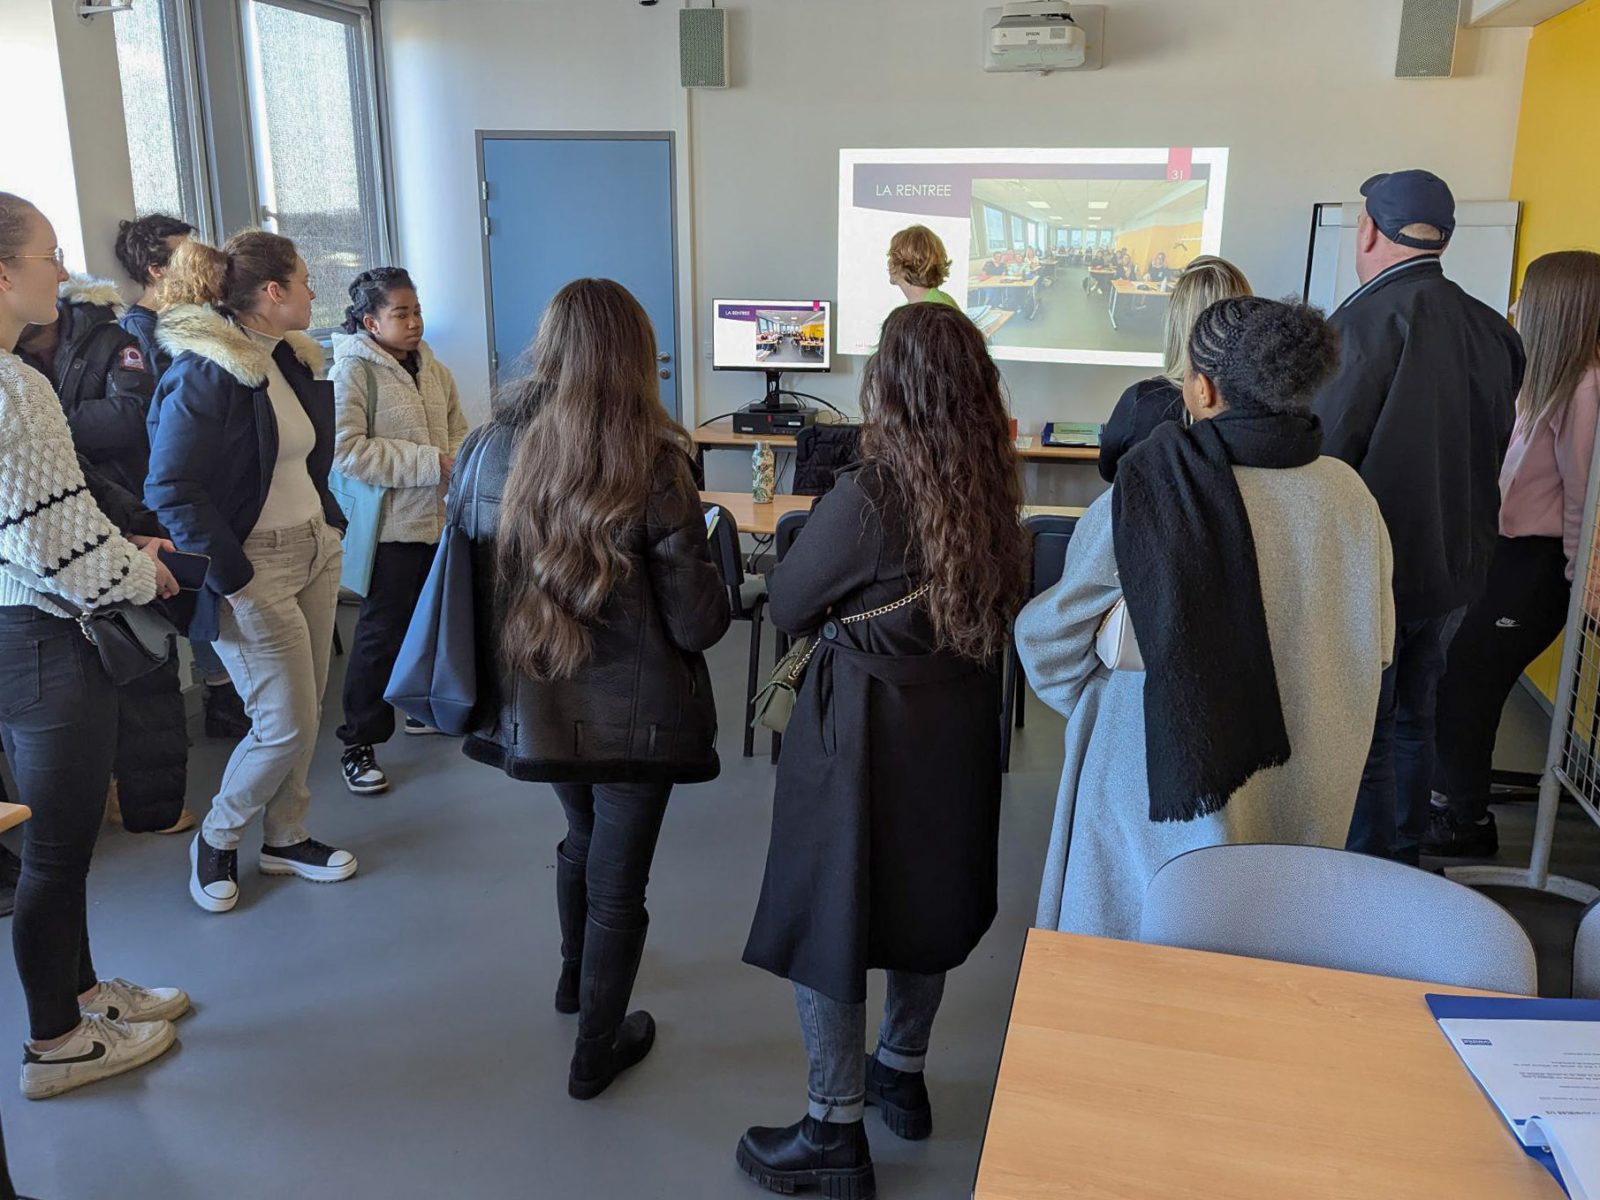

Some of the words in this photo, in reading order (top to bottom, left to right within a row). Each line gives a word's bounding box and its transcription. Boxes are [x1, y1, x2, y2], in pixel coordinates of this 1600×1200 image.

[1171, 169, 1183, 180] 31
[875, 184, 892, 196] LA
[896, 184, 952, 197] RENTREE
